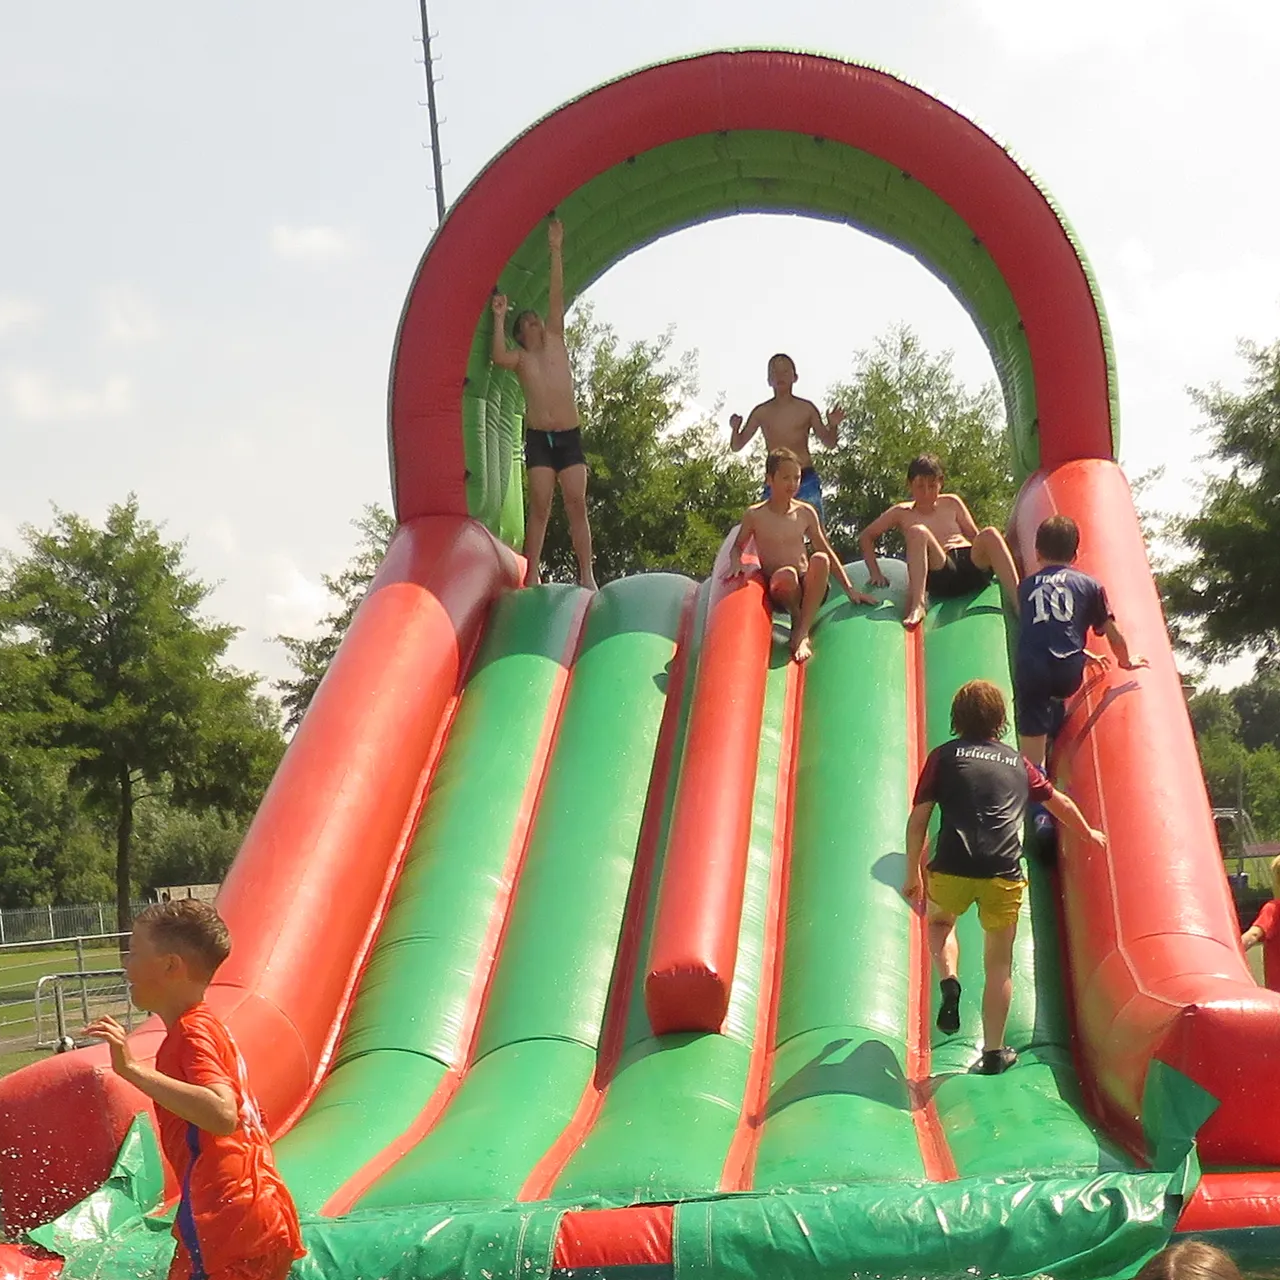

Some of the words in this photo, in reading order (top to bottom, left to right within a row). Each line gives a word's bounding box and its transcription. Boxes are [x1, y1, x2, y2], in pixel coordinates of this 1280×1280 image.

[1034, 573, 1067, 585] FINN
[1027, 585, 1074, 624] 10
[955, 747, 1018, 767] Belucci.nl
